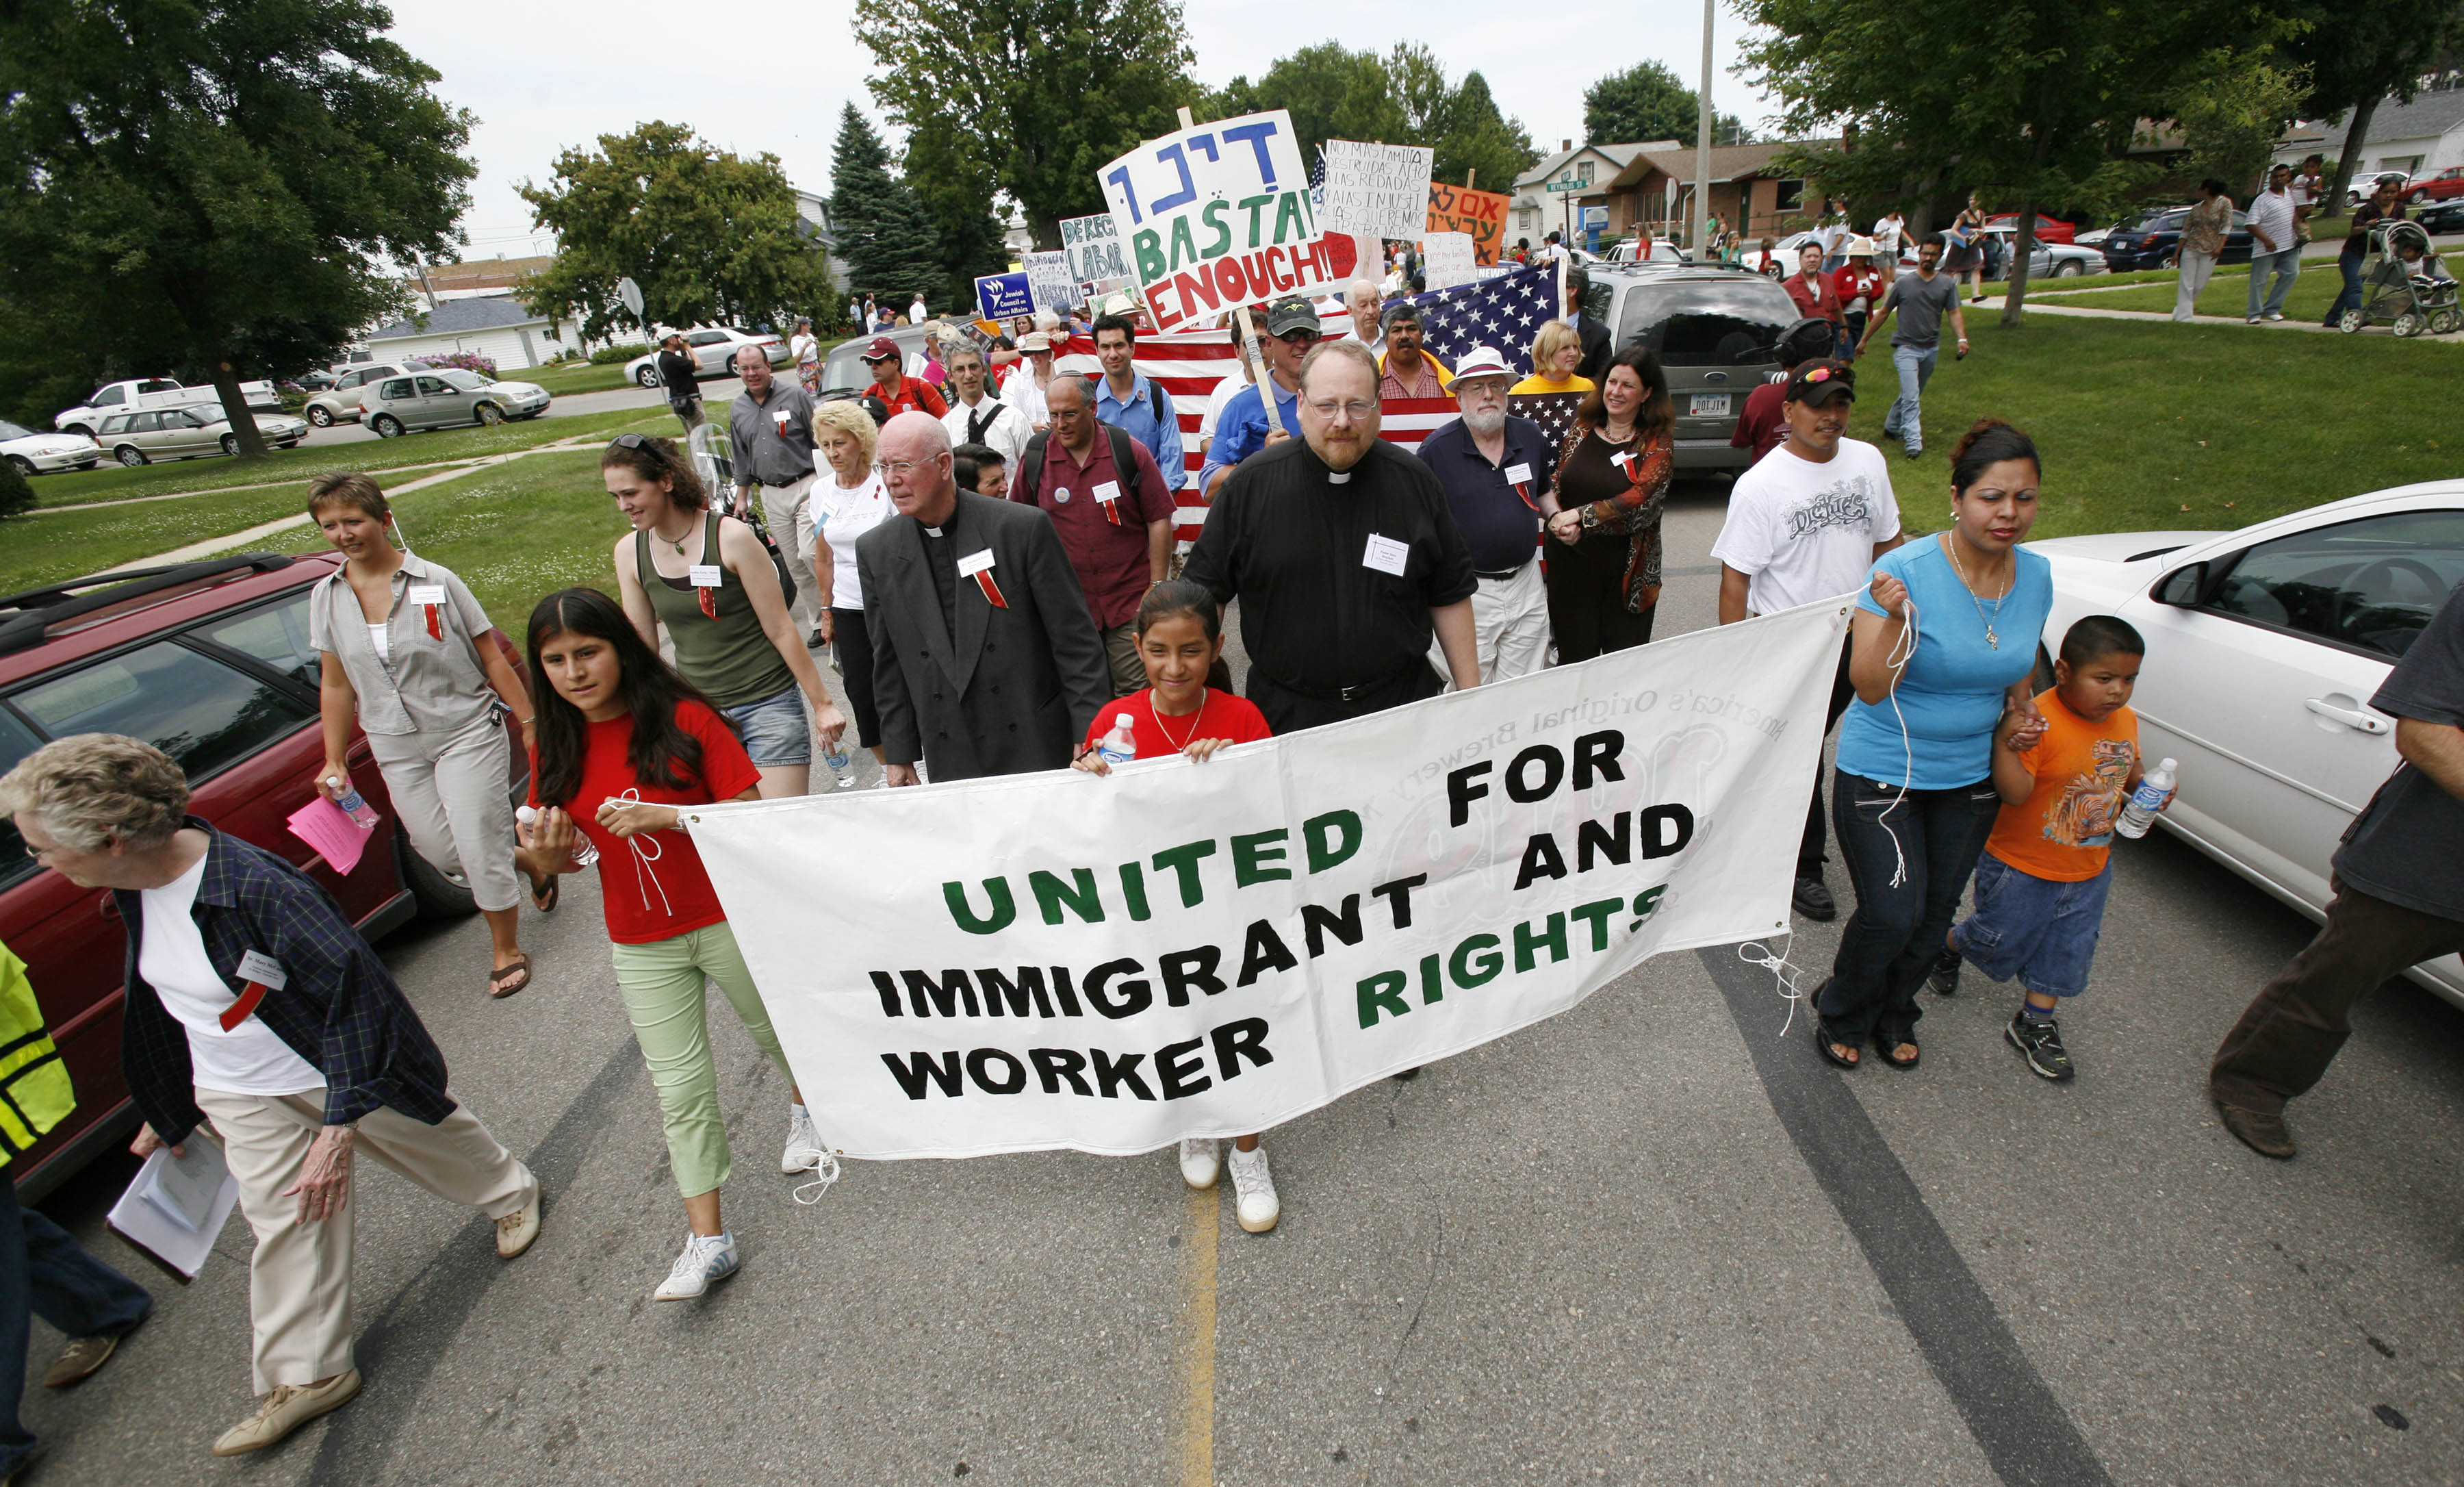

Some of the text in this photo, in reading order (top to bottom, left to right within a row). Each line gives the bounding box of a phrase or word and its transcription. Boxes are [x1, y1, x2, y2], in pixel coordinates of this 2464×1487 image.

[1330, 141, 1346, 155] NO
[1351, 142, 1379, 158] MAS
[1326, 157, 1392, 175] DESTRUIDAS
[1326, 171, 1421, 192] A LAS REDADAS
[1326, 190, 1331, 201] Y
[1331, 218, 1407, 238] TRABAJAR
[1356, 209, 1426, 229] QUEREMOS
[1132, 189, 1318, 287] BASTA!
[1478, 268, 1506, 278] NEWS
[1004, 290, 1025, 298] Jewish
[1144, 240, 1333, 331] ENOUGH!
[993, 306, 1029, 317] Urban Affairs
[1000, 299, 1020, 308] Council
[942, 728, 1626, 936] UNITED FOR
[868, 872, 1428, 1020] IMMIGRANT
[1513, 803, 1694, 890] AND
[881, 1017, 1274, 1101] WORKER
[1356, 883, 1669, 1029] RIGHTS
